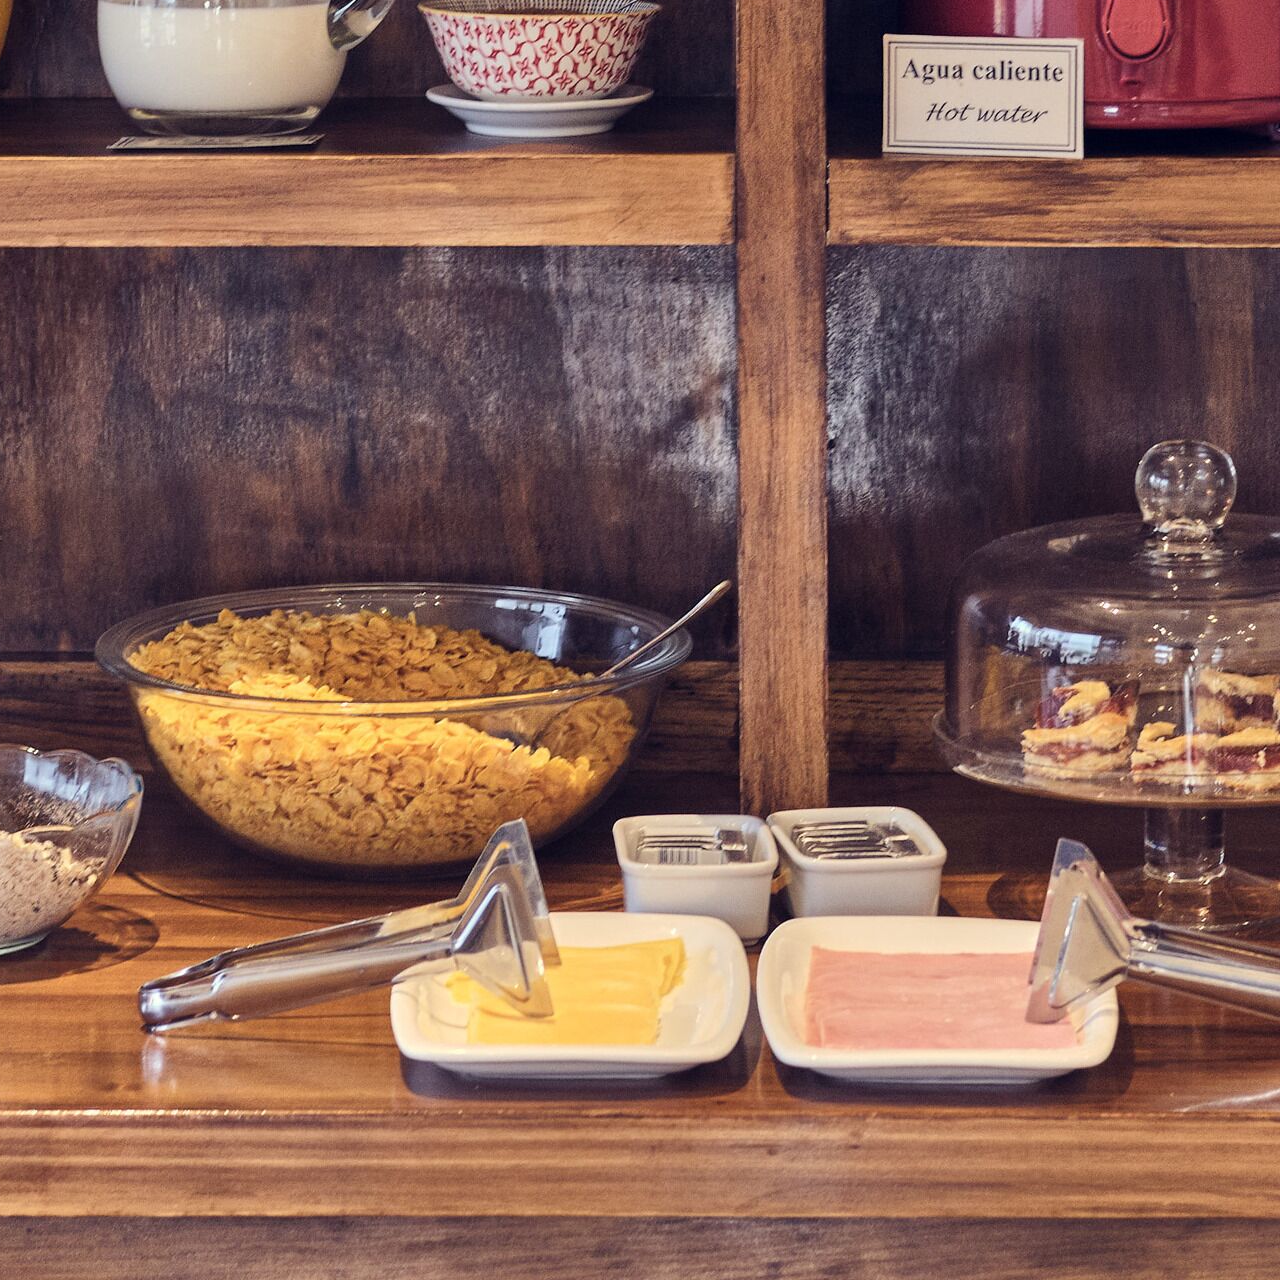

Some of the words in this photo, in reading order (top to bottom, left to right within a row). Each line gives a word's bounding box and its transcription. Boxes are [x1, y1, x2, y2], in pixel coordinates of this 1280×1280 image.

[901, 59, 964, 85] Agua
[972, 60, 1064, 83] caliente
[926, 101, 975, 122] Hot
[977, 104, 1049, 124] water
